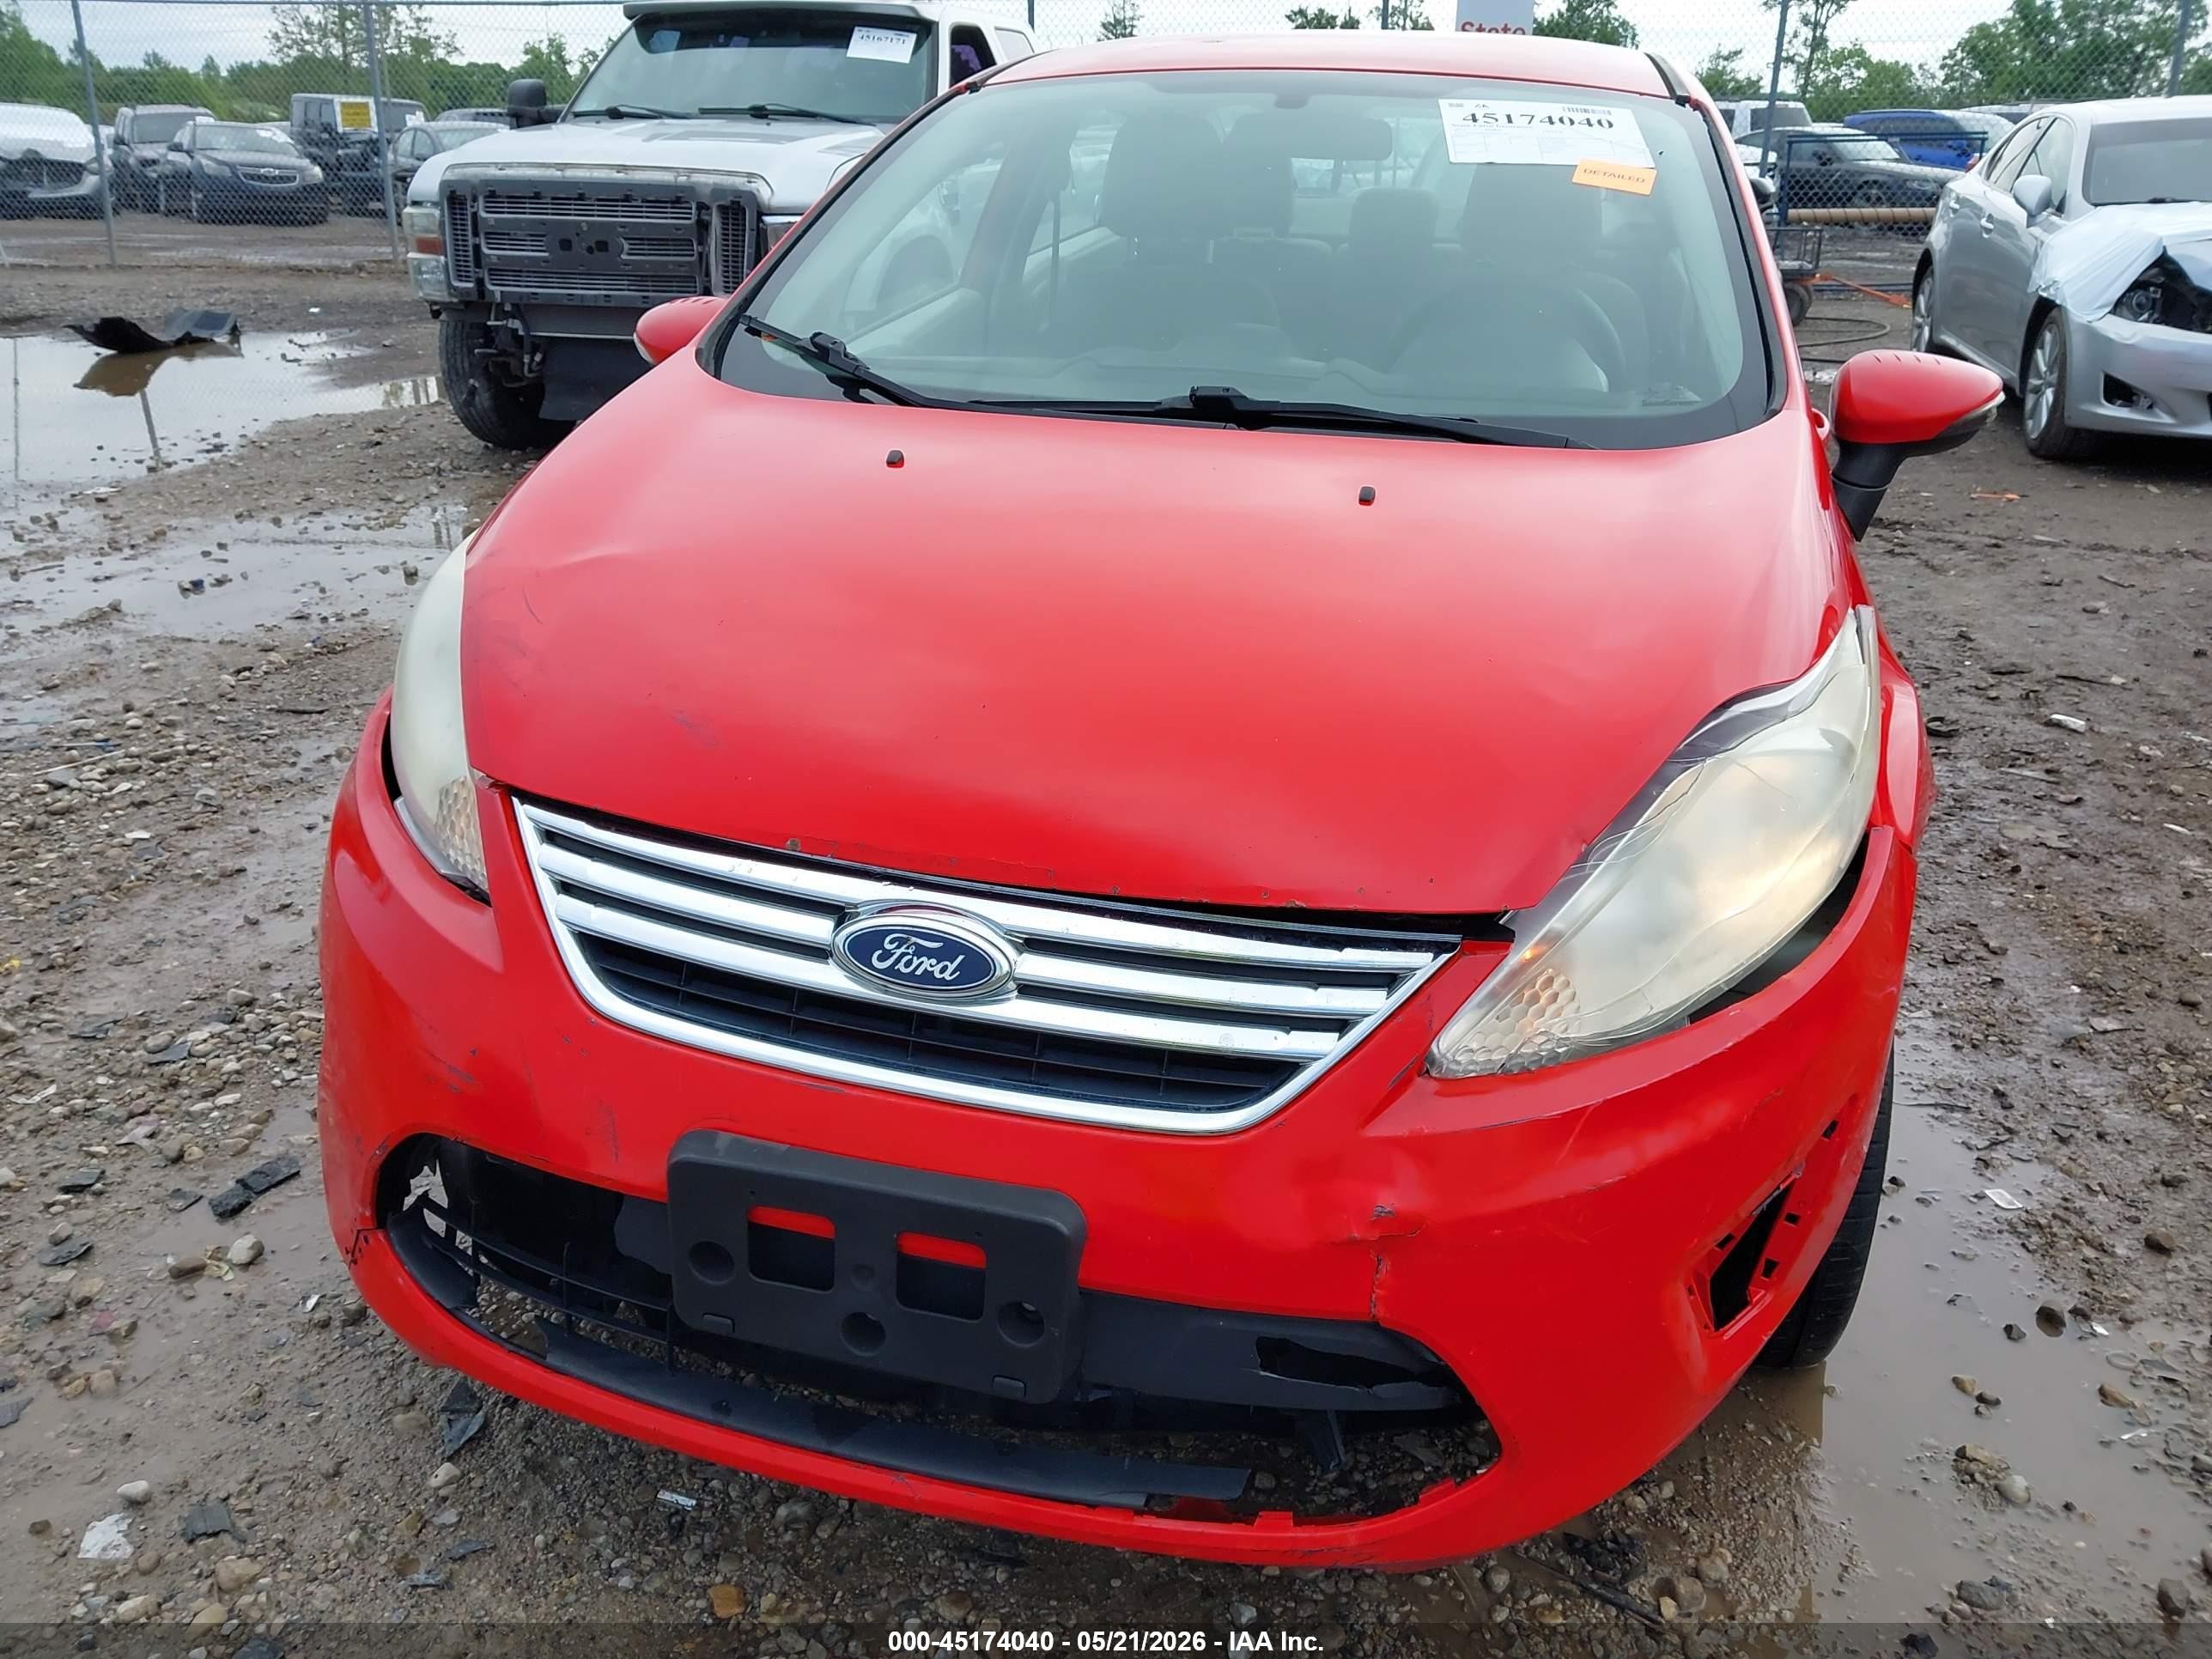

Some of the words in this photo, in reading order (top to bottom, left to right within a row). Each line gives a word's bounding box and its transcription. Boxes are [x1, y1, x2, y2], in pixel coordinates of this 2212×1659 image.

[1462, 112, 1614, 130] 45174040
[1583, 167, 1646, 184] DETAILED
[871, 933, 966, 981] Ford
